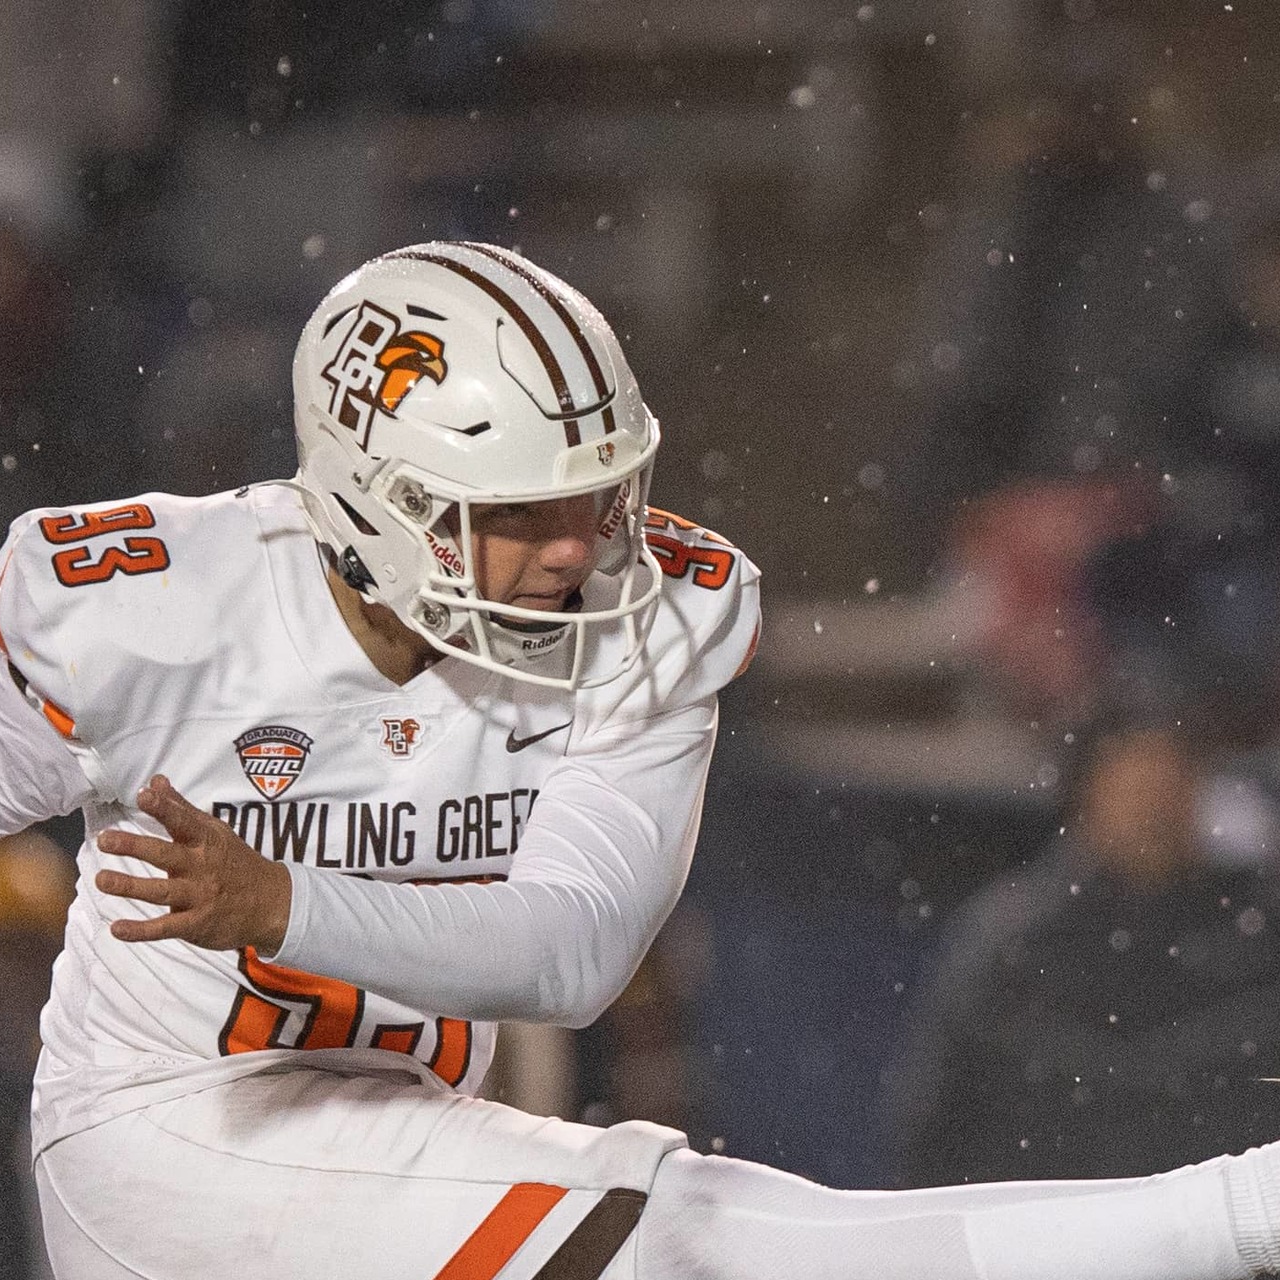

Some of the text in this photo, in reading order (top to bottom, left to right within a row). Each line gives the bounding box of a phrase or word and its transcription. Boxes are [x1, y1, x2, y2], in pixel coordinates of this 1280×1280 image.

[39, 504, 170, 588] 93
[246, 728, 301, 742] GRADUATE
[244, 758, 301, 775] MAC
[436, 789, 540, 862] GREE
